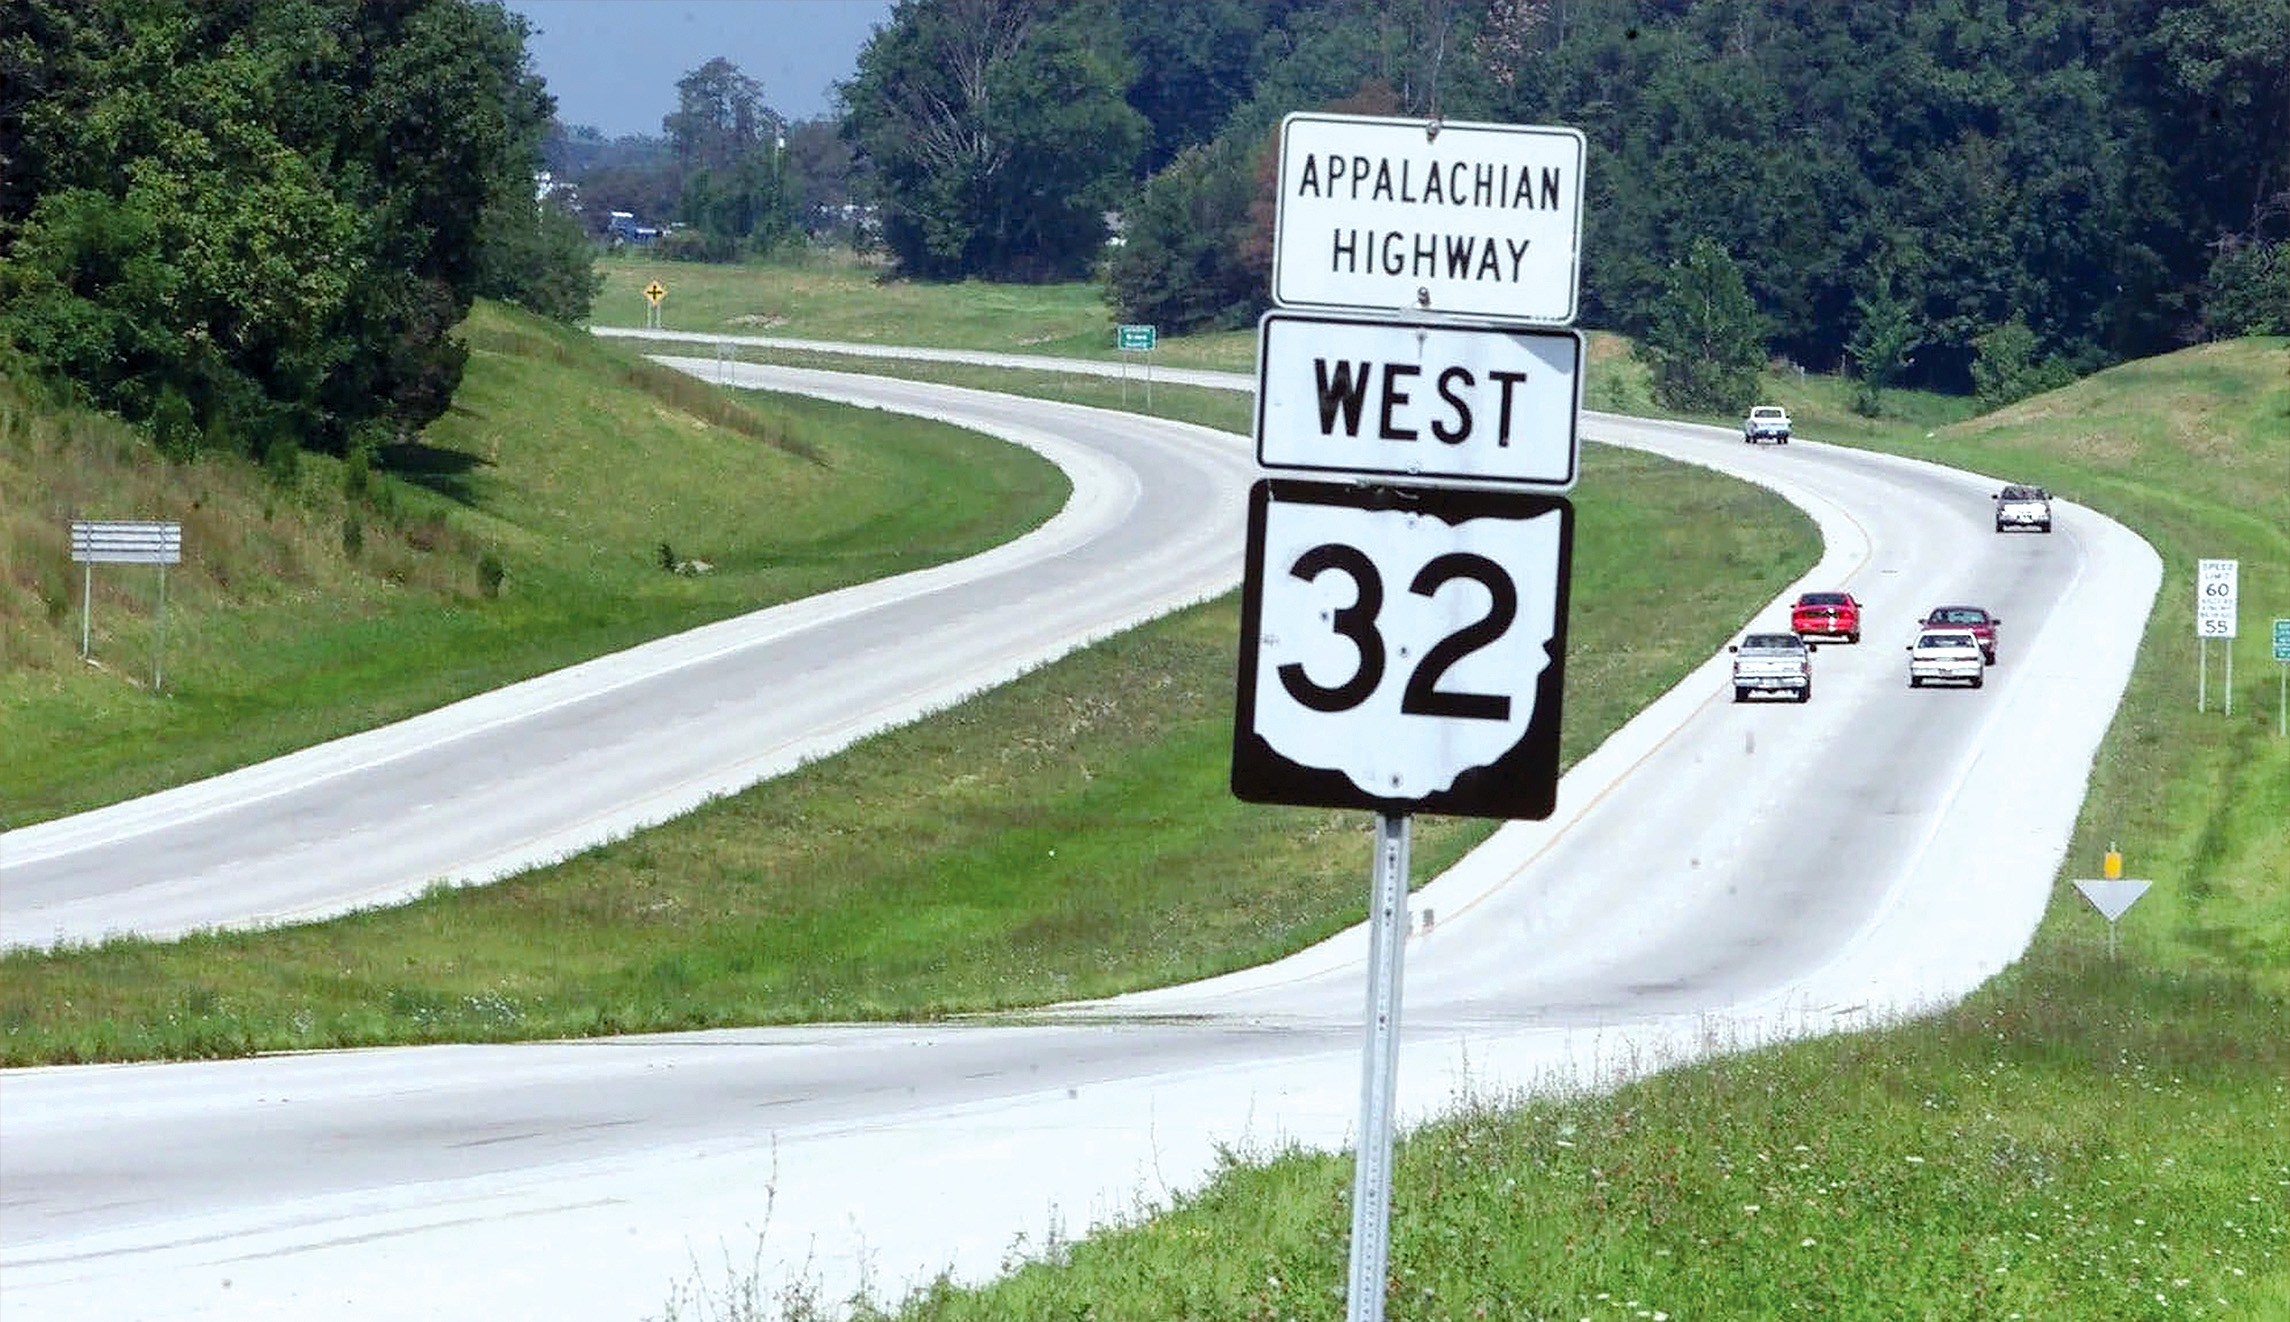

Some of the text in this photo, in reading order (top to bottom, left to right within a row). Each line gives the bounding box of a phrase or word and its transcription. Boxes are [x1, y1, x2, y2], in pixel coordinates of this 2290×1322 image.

[1299, 154, 1559, 210] APPALACHIAN
[1333, 229, 1529, 283] HIGHWAY
[1314, 358, 1527, 448] WEST
[2206, 583, 2229, 597] 60
[1277, 543, 1518, 721] 32
[2205, 619, 2228, 634] 55
